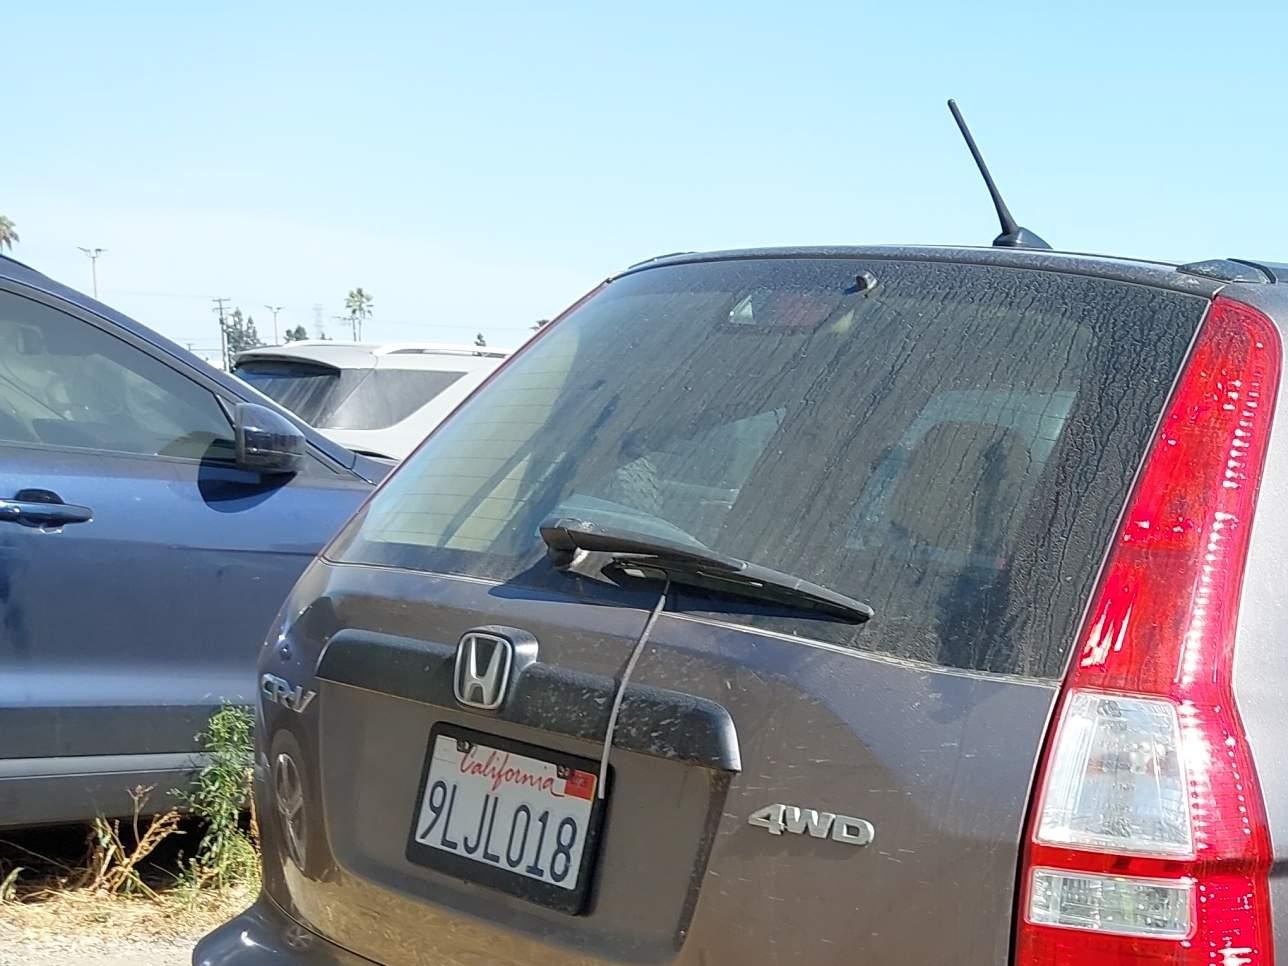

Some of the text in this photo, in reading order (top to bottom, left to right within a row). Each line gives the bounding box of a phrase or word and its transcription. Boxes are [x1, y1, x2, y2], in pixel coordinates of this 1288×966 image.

[458, 746, 565, 798] California
[419, 780, 577, 883] 9LJL018
[748, 803, 875, 846] 4WD
